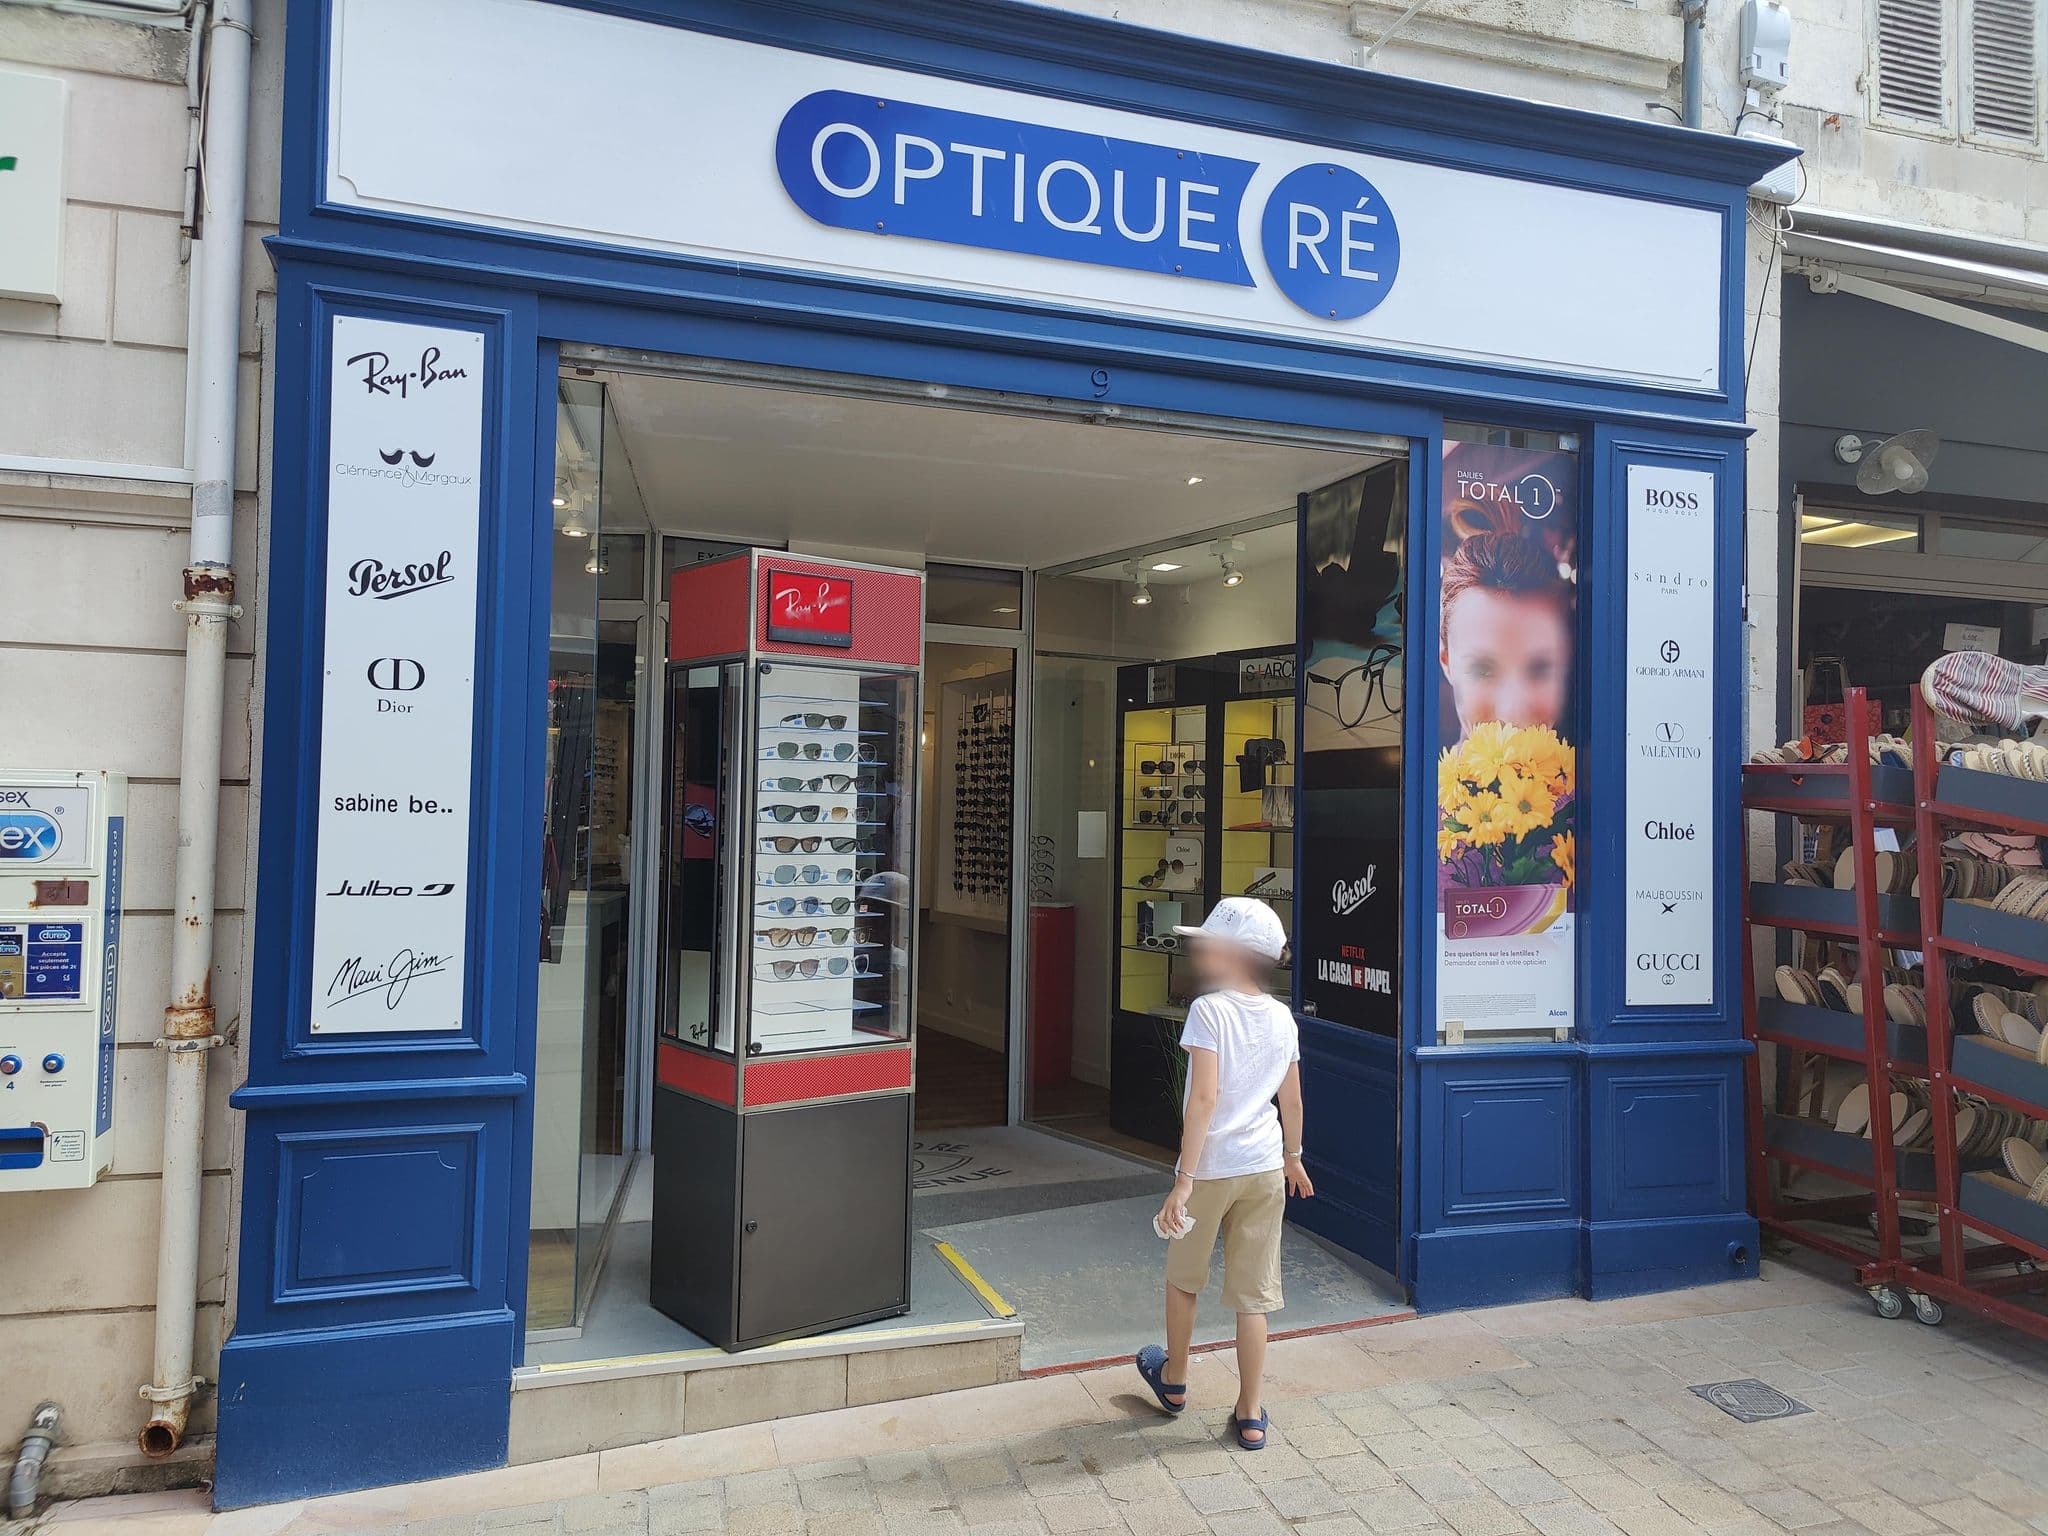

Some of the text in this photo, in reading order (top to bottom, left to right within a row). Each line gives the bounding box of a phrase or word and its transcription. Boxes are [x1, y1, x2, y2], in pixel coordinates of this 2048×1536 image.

[811, 122, 1380, 282] OPTIQUE RÉ
[1091, 368, 1110, 398] 9
[335, 463, 402, 480] Clémence
[415, 470, 472, 486] Margaux
[1457, 470, 1483, 480] DAILIES
[1457, 480, 1524, 505] TOTAL
[1646, 489, 1698, 510] BOSS
[348, 550, 455, 600] Persol
[1634, 570, 1708, 588] sandro
[1661, 587, 1679, 596] PARIS
[1635, 666, 1705, 679] GIORGIO ARMANI
[377, 698, 414, 714] Dior
[1641, 745, 1701, 760] VALENTINO
[334, 793, 399, 813] sabine
[1644, 821, 1695, 840] Chloé
[326, 880, 412, 897] Julbo
[1332, 863, 1377, 915] Persol
[1635, 890, 1704, 901] MAUBOUSSIN
[1456, 903, 1492, 915] TOTAL
[42, 931, 68, 940] durex
[1341, 945, 1366, 960] NETFLIX
[1444, 950, 1457, 958] Des
[1458, 950, 1488, 960] questions
[1511, 949, 1535, 957] lentilles
[1444, 959, 1477, 967] Demandez
[1523, 958, 1547, 967] opticien
[1636, 953, 1700, 971] GUCCI
[327, 948, 454, 1010] Maui Jim
[1318, 958, 1391, 995] LA CASA DE PAPEL
[1548, 1009, 1568, 1017] Alcon
[6, 1081, 15, 1090] 4
[101, 1044, 110, 1120] condoms
